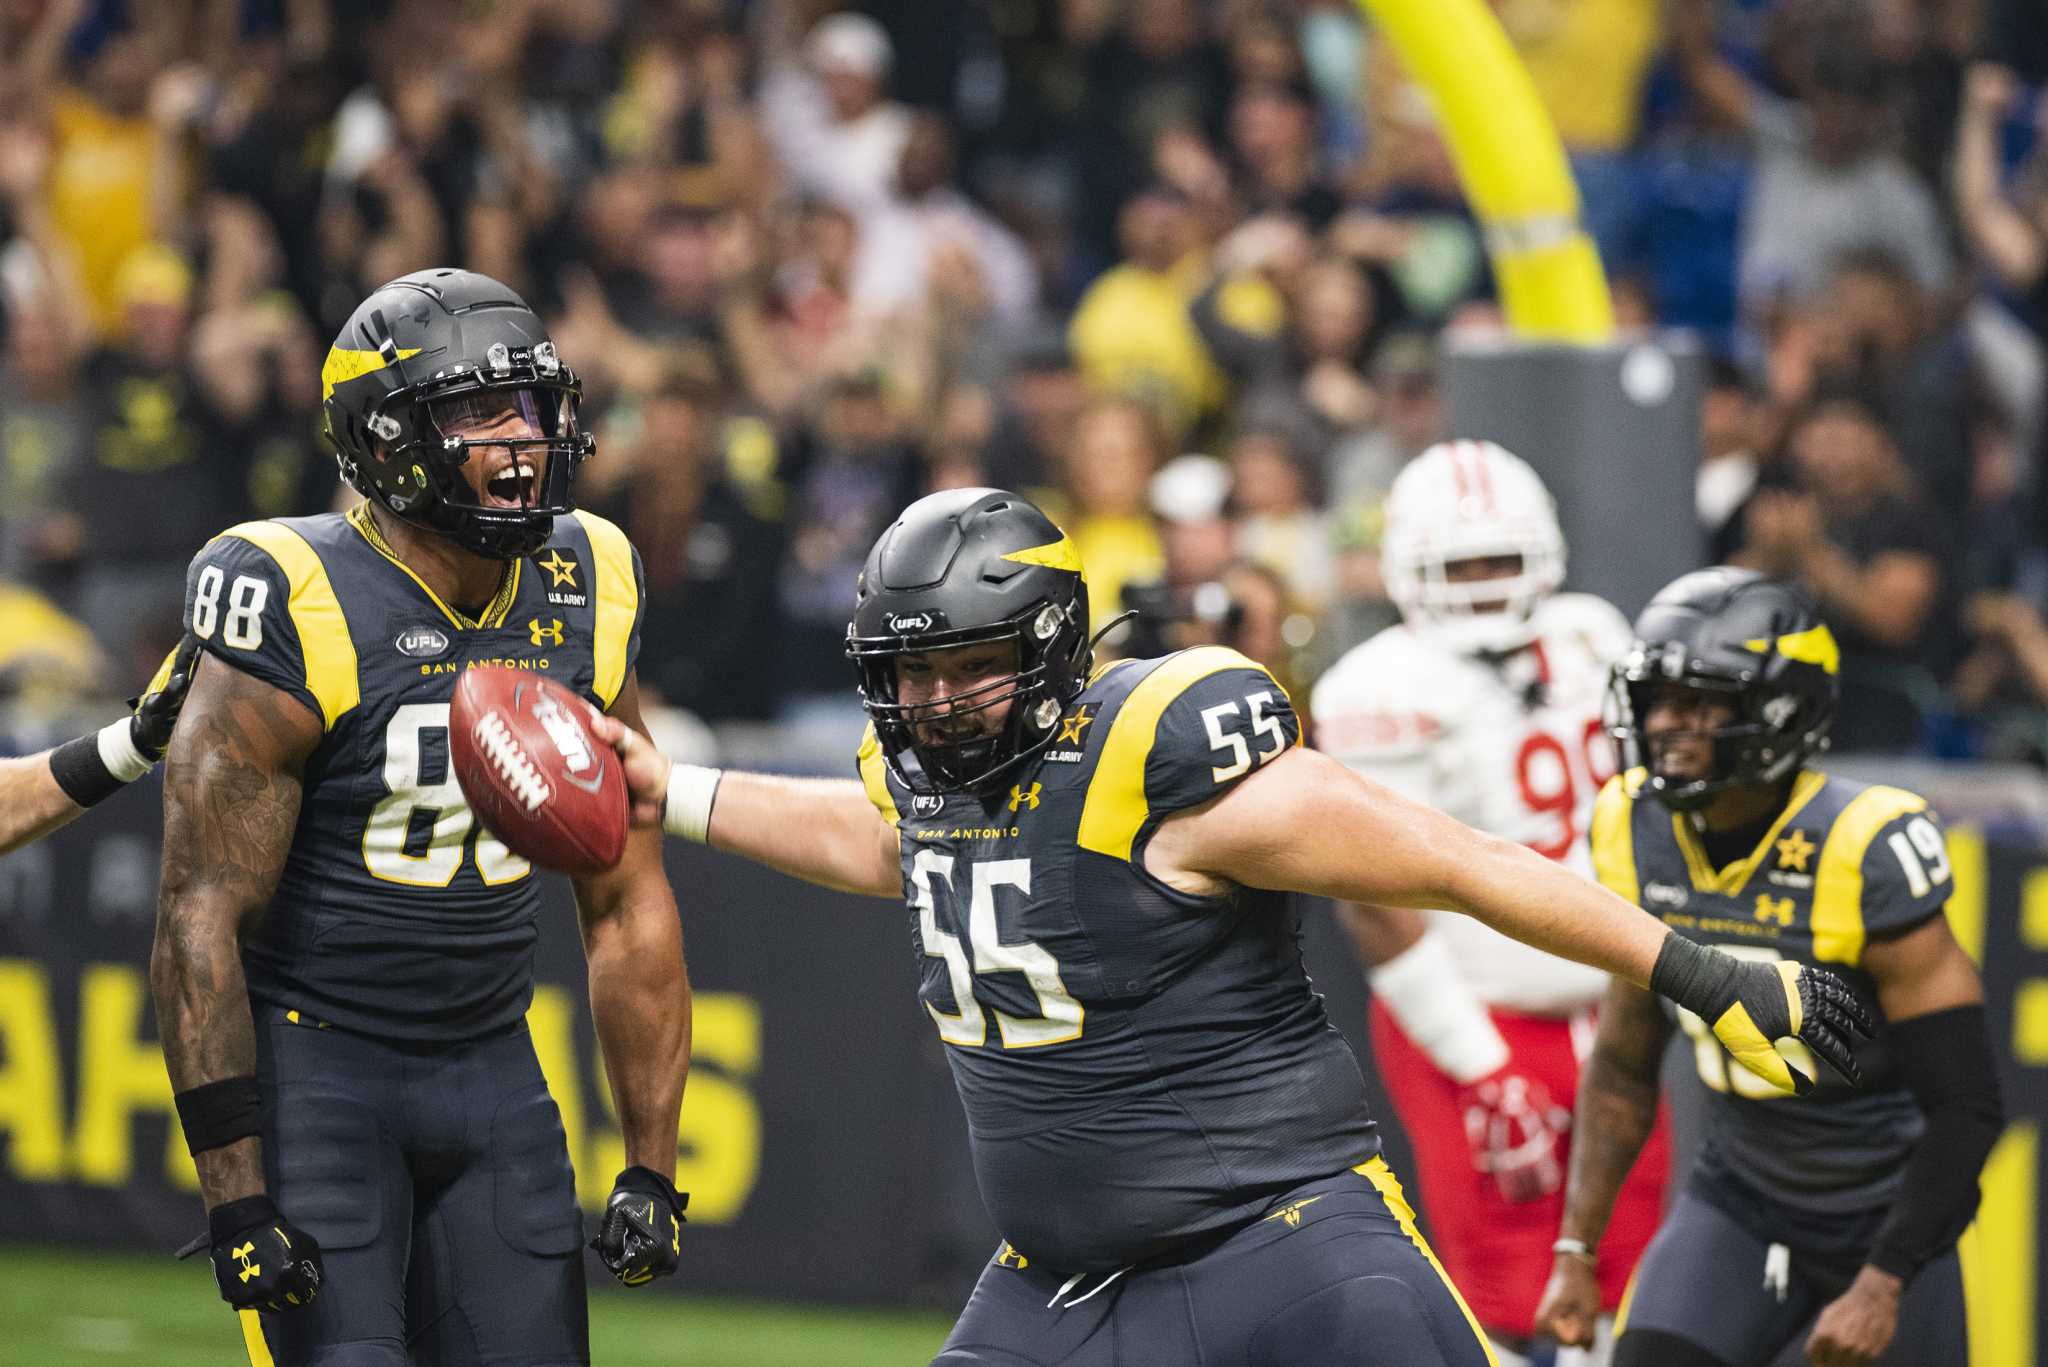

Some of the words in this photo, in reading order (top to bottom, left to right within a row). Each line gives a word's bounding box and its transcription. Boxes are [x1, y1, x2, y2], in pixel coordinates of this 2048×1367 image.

[548, 592, 563, 604] U.S.
[564, 593, 586, 606] ARMY
[192, 564, 268, 651] 88
[897, 617, 925, 630] UFL
[405, 635, 442, 650] UFL
[420, 662, 457, 676] SAN
[467, 658, 550, 673] ANTONIO
[1200, 691, 1286, 784] 55
[1058, 751, 1083, 763] ARMY
[361, 702, 531, 888] 8
[916, 795, 938, 809] UFL
[917, 829, 946, 840] SAN
[950, 826, 1020, 840] ANTONIO
[1887, 816, 1950, 899] 19
[911, 848, 1086, 1050] 55
